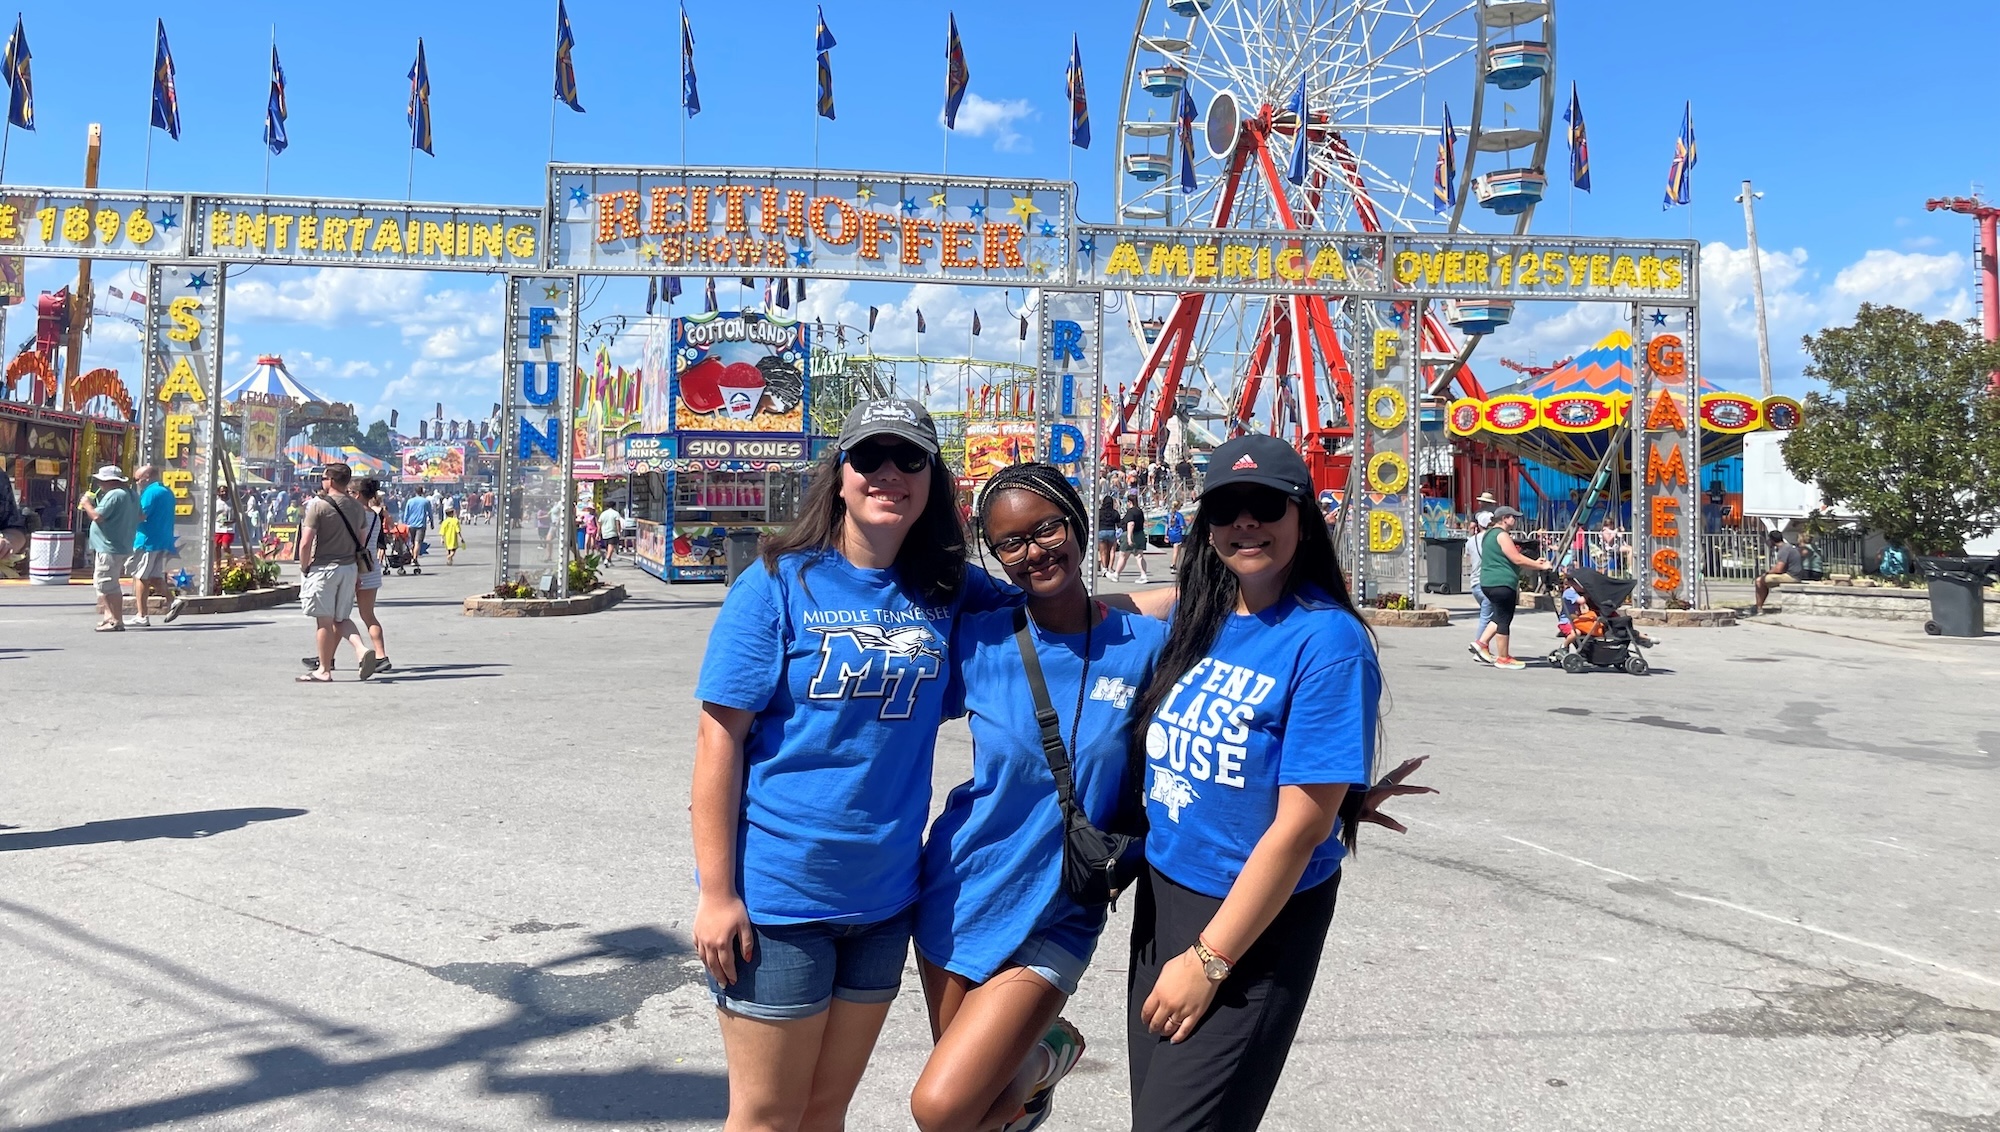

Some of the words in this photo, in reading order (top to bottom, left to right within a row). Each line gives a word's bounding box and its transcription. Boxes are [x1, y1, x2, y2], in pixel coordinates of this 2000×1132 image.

[0, 203, 18, 239] E
[36, 207, 155, 243] 1896
[211, 211, 536, 258] ENTERTAINING
[596, 185, 1026, 270] REITHOFFER
[661, 236, 787, 267] SHOWS
[1104, 242, 1347, 282] AMERICA
[1394, 249, 1490, 286] OVER
[1567, 253, 1681, 290] YEARS
[685, 319, 746, 346] COTTON
[747, 321, 797, 349] CANDY
[519, 306, 560, 462] FUN
[159, 297, 206, 517] SAFE
[629, 439, 661, 449] COLD
[688, 440, 731, 457] SNO
[735, 441, 802, 457] KONES
[1001, 423, 1035, 435] PIZZA
[1366, 329, 1409, 554] FOOD
[626, 448, 670, 459] DRINKS
[1645, 333, 1689, 592] GAMES
[803, 610, 870, 624] MIDDLE
[873, 606, 950, 624] TENNESSEE
[808, 631, 941, 720] MT
[1089, 675, 1137, 710] MT
[1182, 657, 1276, 705] FEND
[1158, 683, 1255, 744] LASS
[1149, 769, 1194, 824] MT
